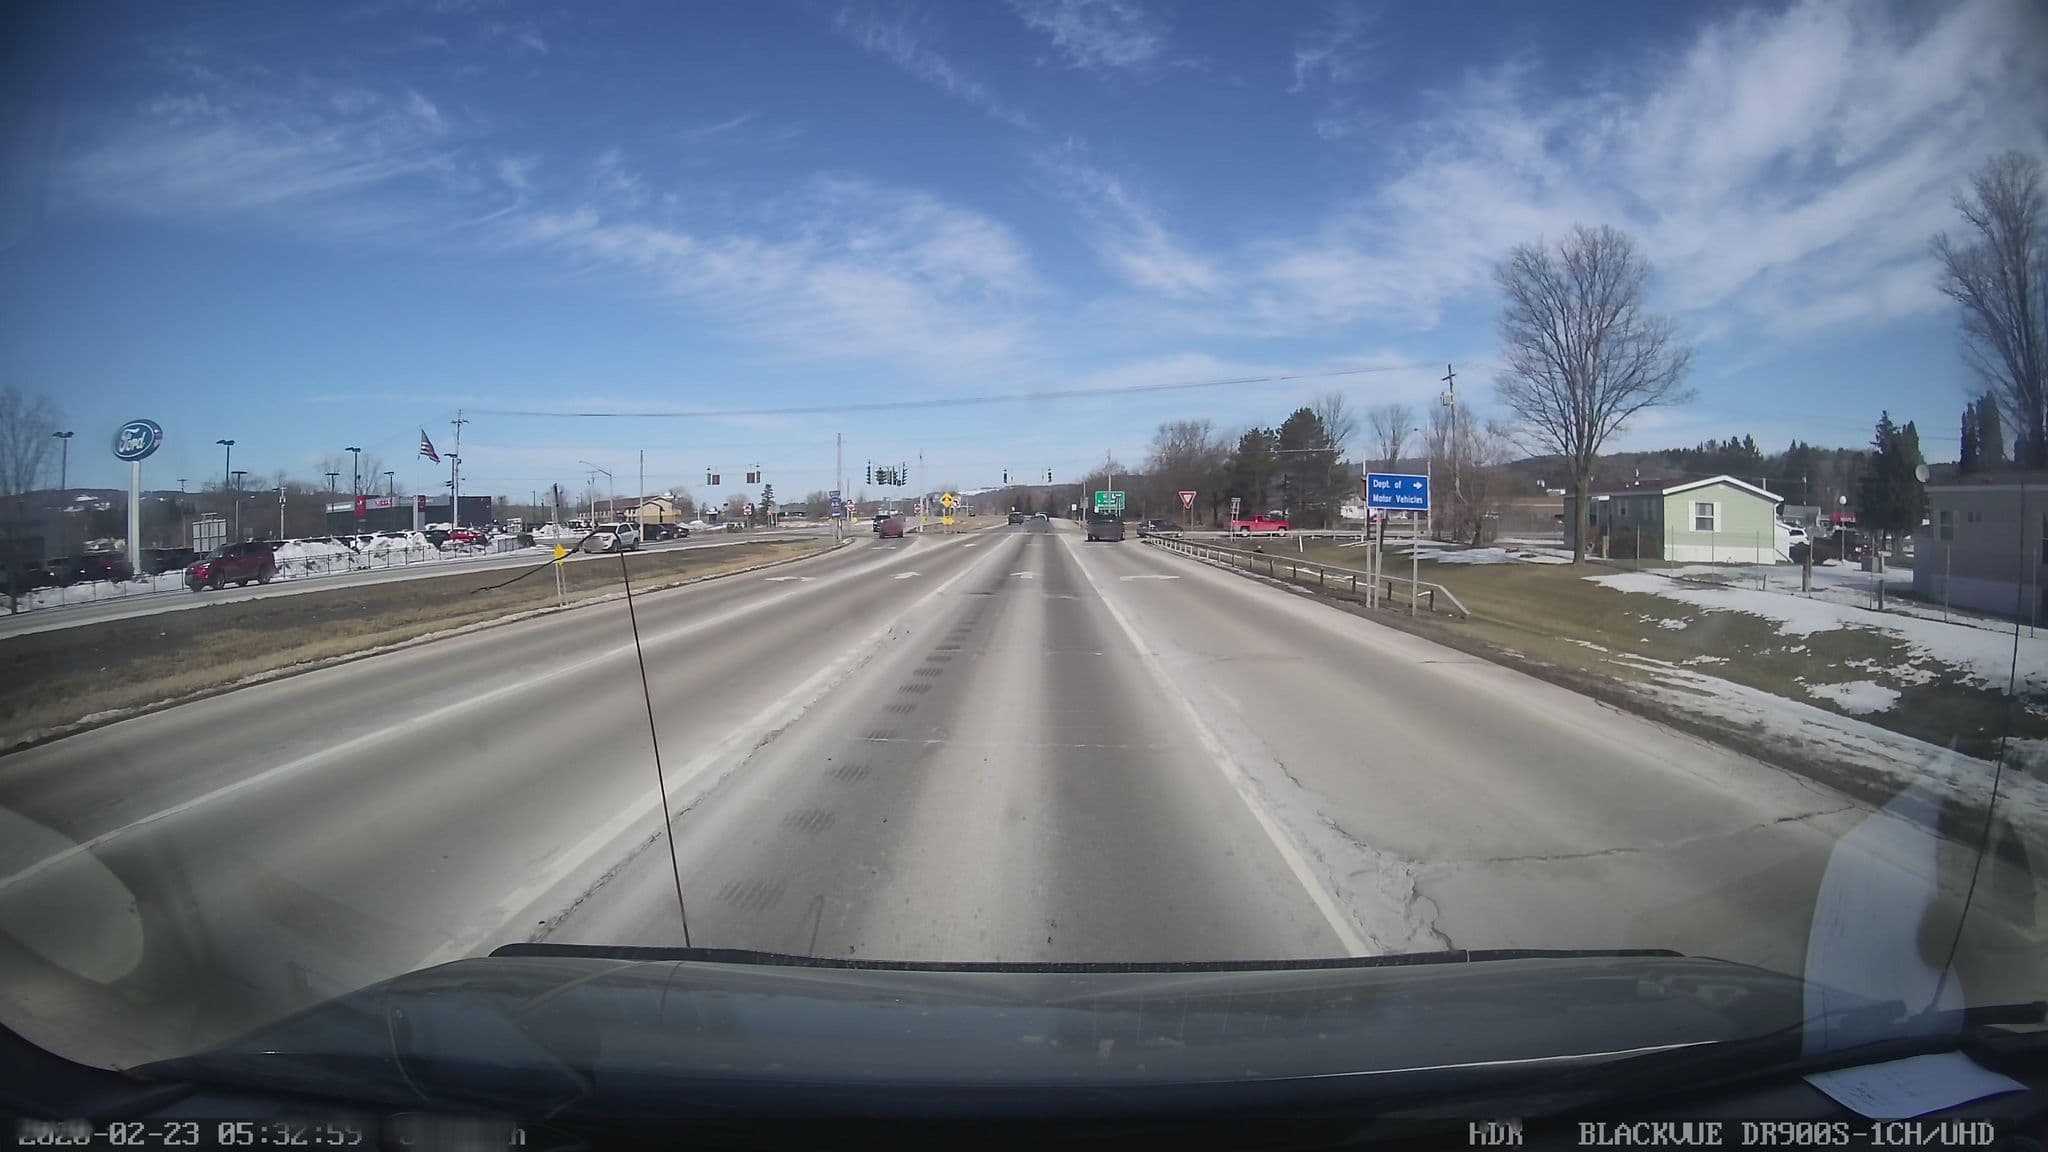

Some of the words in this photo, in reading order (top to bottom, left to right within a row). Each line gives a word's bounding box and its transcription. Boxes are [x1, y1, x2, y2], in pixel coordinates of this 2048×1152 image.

[119, 428, 146, 452] Ford
[1373, 479, 1391, 490] Dept.
[1394, 480, 1402, 489] of
[1373, 494, 1392, 503] Motor
[1395, 494, 1423, 504] Vehicles
